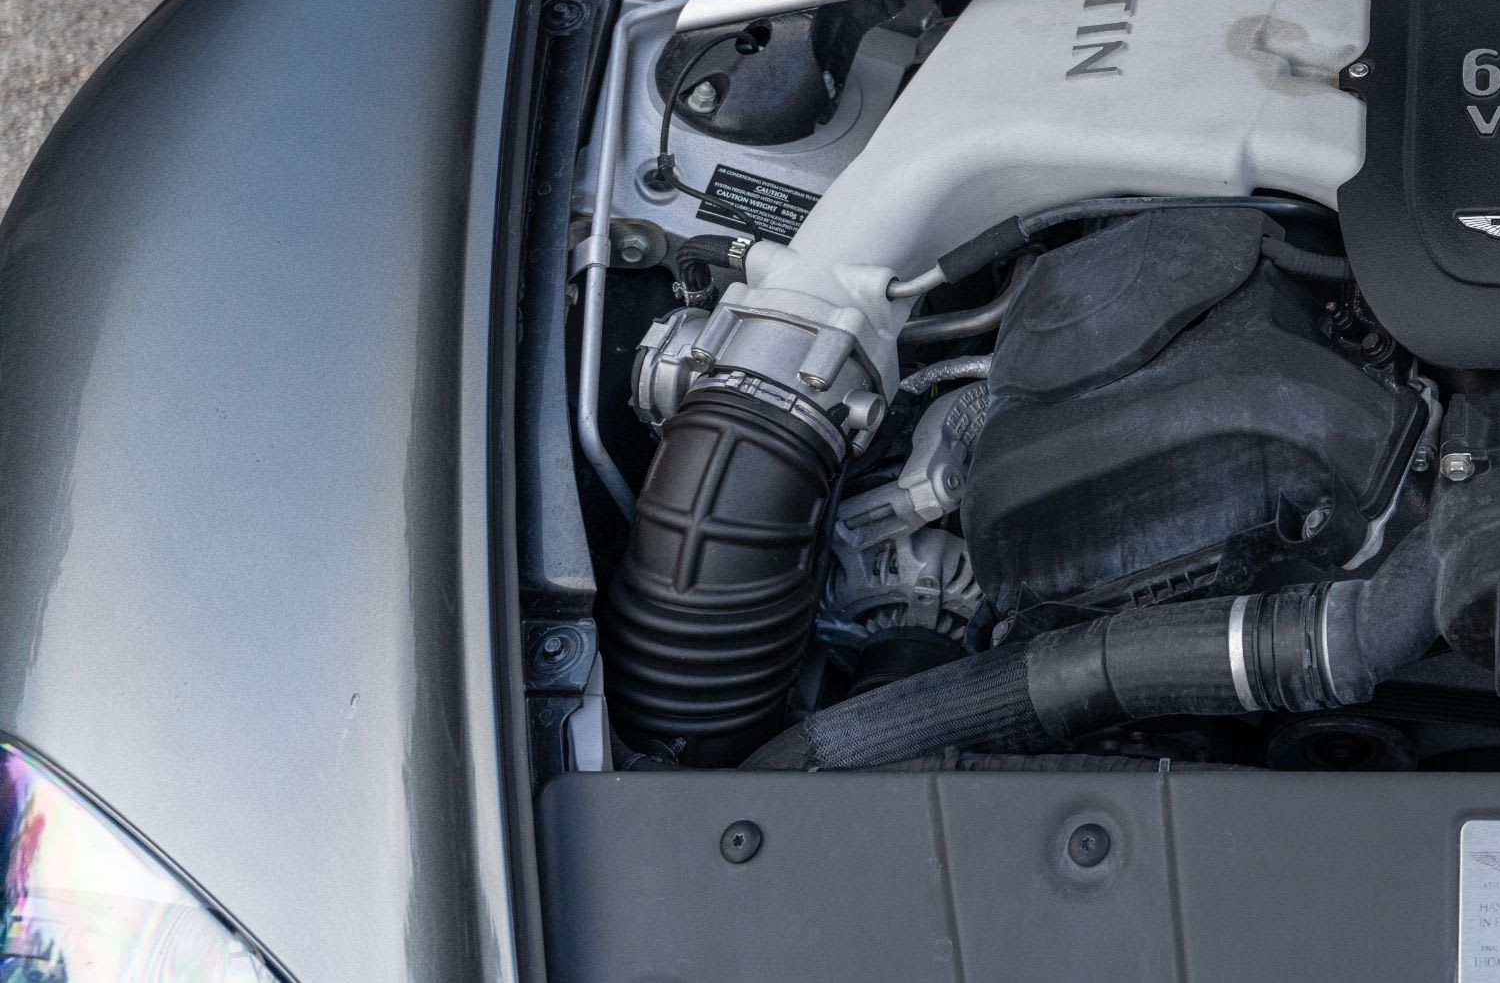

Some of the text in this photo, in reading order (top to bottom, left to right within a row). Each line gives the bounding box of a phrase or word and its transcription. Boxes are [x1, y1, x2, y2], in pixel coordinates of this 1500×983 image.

[716, 189, 750, 205] CAUTION
[749, 197, 779, 213] WEIGHT
[755, 185, 789, 201] CAUTION
[1480, 917, 1491, 928] IN
